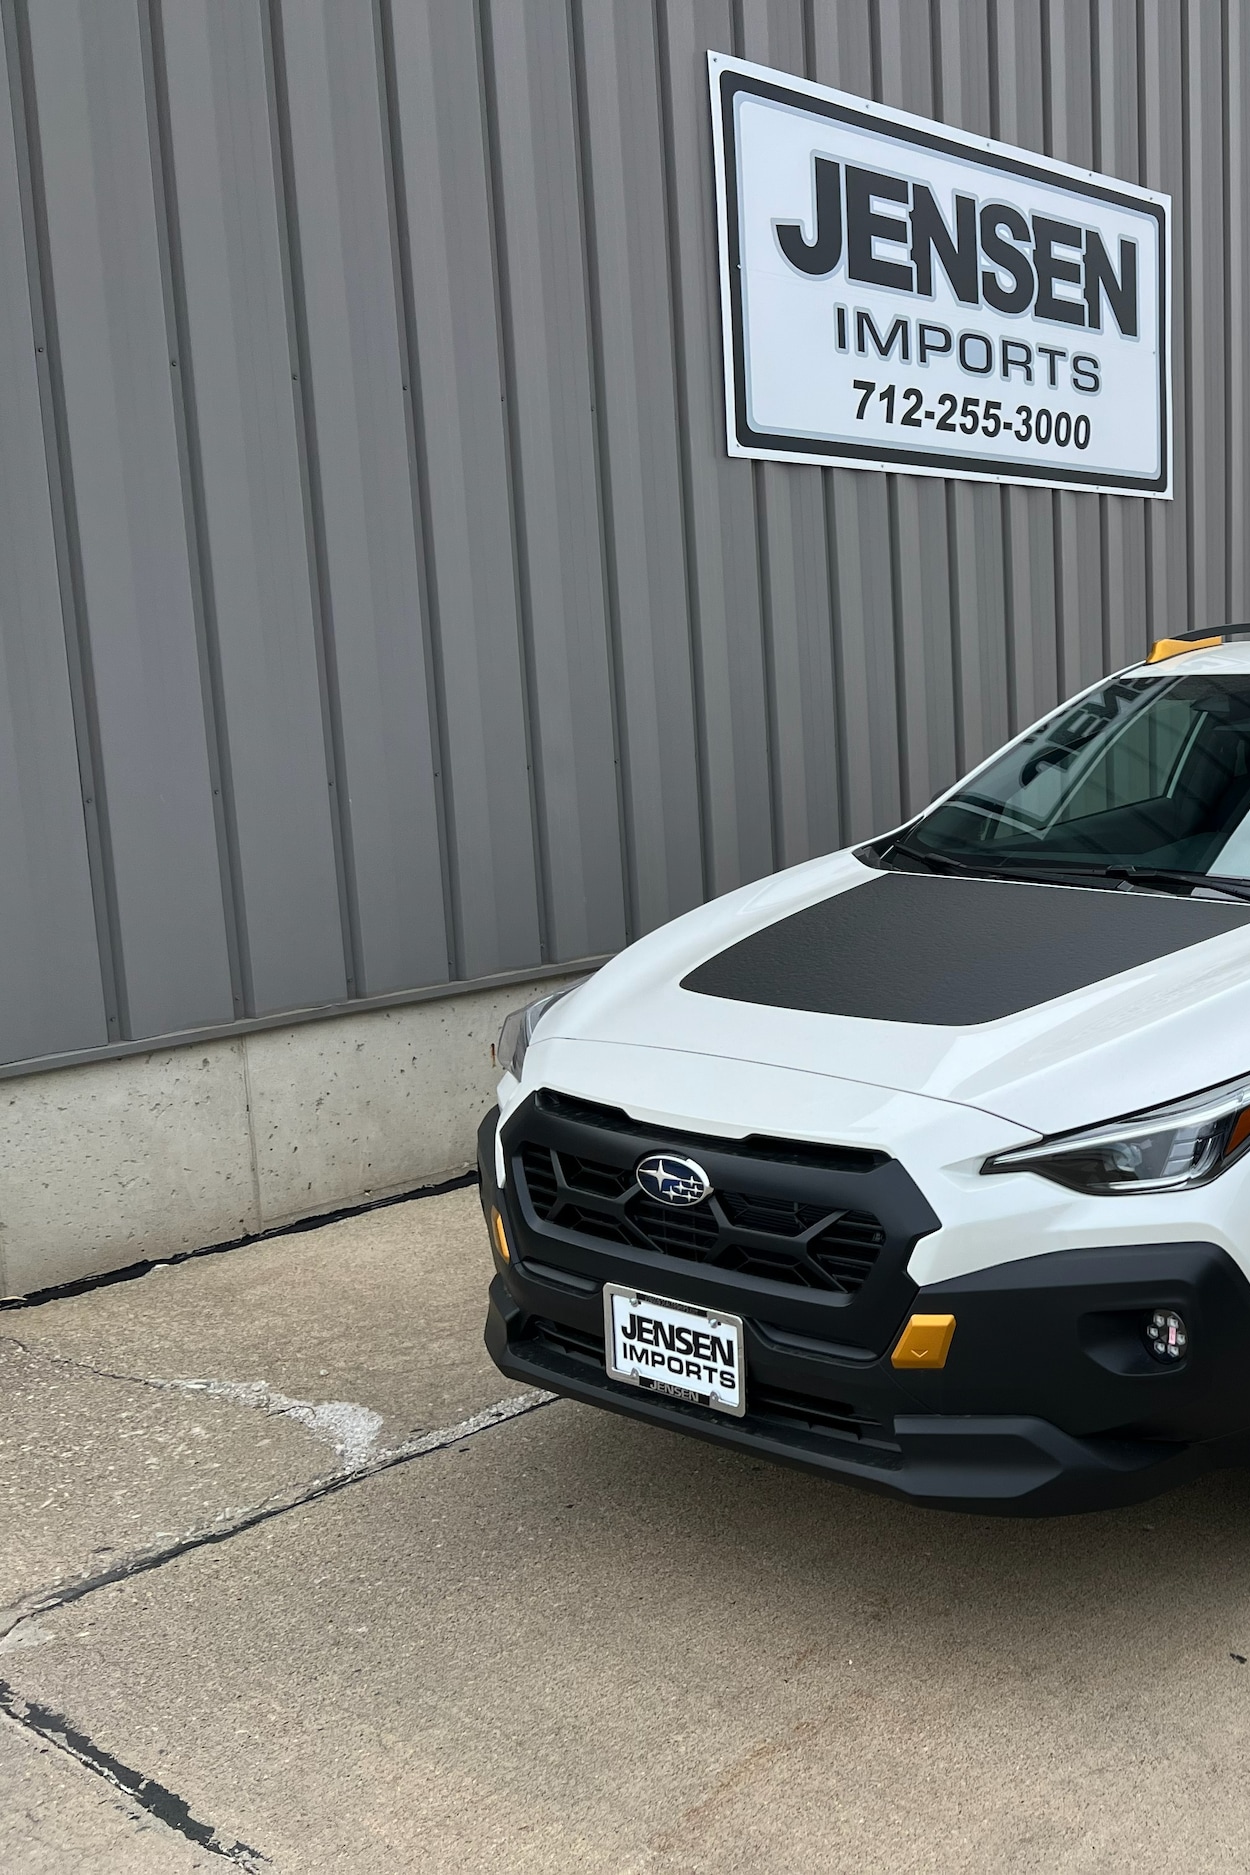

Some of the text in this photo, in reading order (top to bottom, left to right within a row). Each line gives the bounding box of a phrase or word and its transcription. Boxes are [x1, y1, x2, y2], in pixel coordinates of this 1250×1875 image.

[775, 155, 1139, 338] JENSEN
[835, 305, 1102, 396] IMPORTS
[852, 379, 1091, 450] 712-255-3000
[621, 1313, 735, 1368] JENSEN
[622, 1342, 736, 1390] IMPORTS
[649, 1380, 699, 1403] JENSEN
